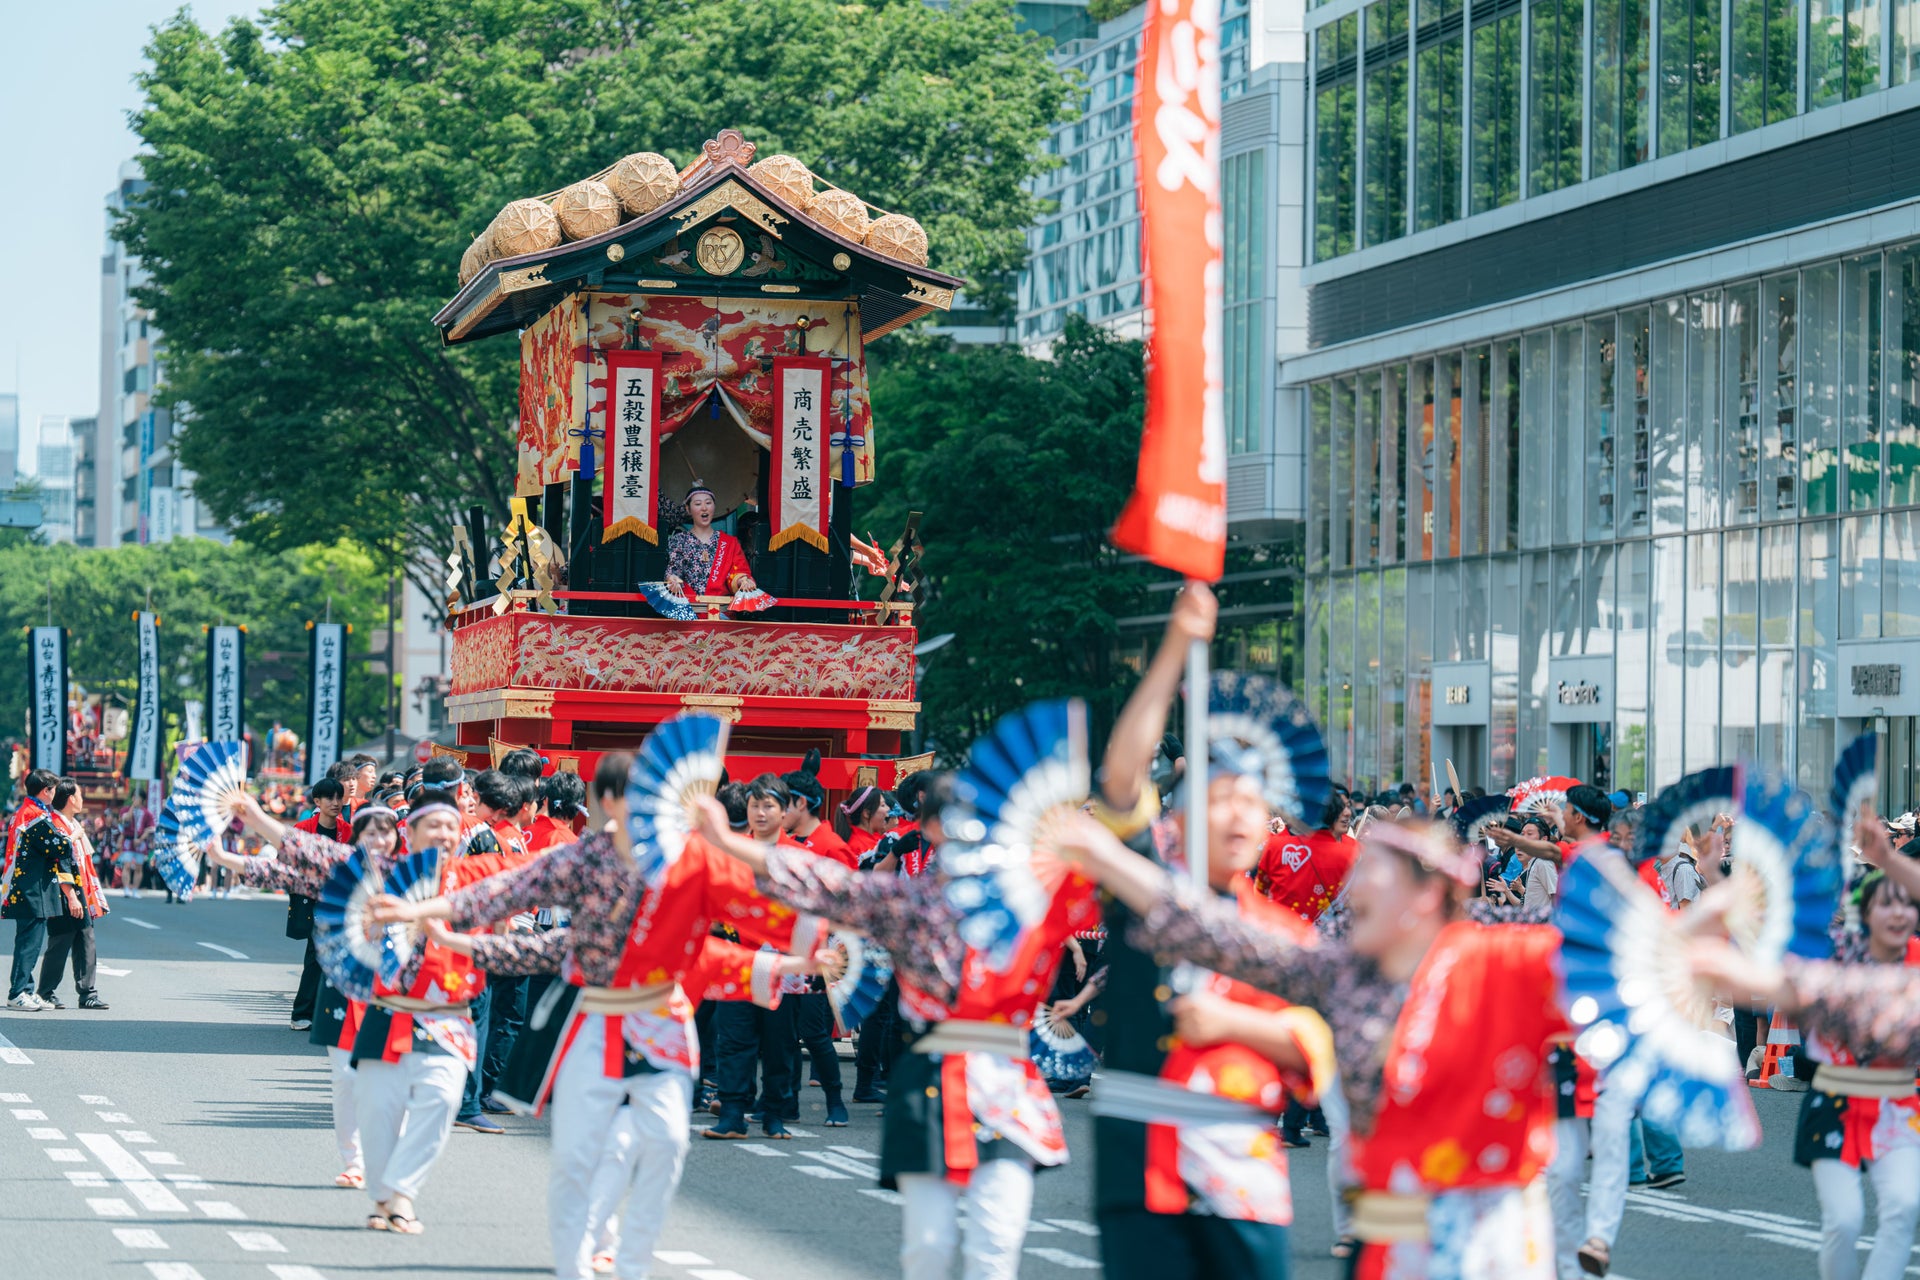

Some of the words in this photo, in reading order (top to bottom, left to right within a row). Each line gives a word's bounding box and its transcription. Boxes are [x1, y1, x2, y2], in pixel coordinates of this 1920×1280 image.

[621, 378, 645, 498] 五穀豊穣臺
[790, 387, 814, 500] 商売繁盛
